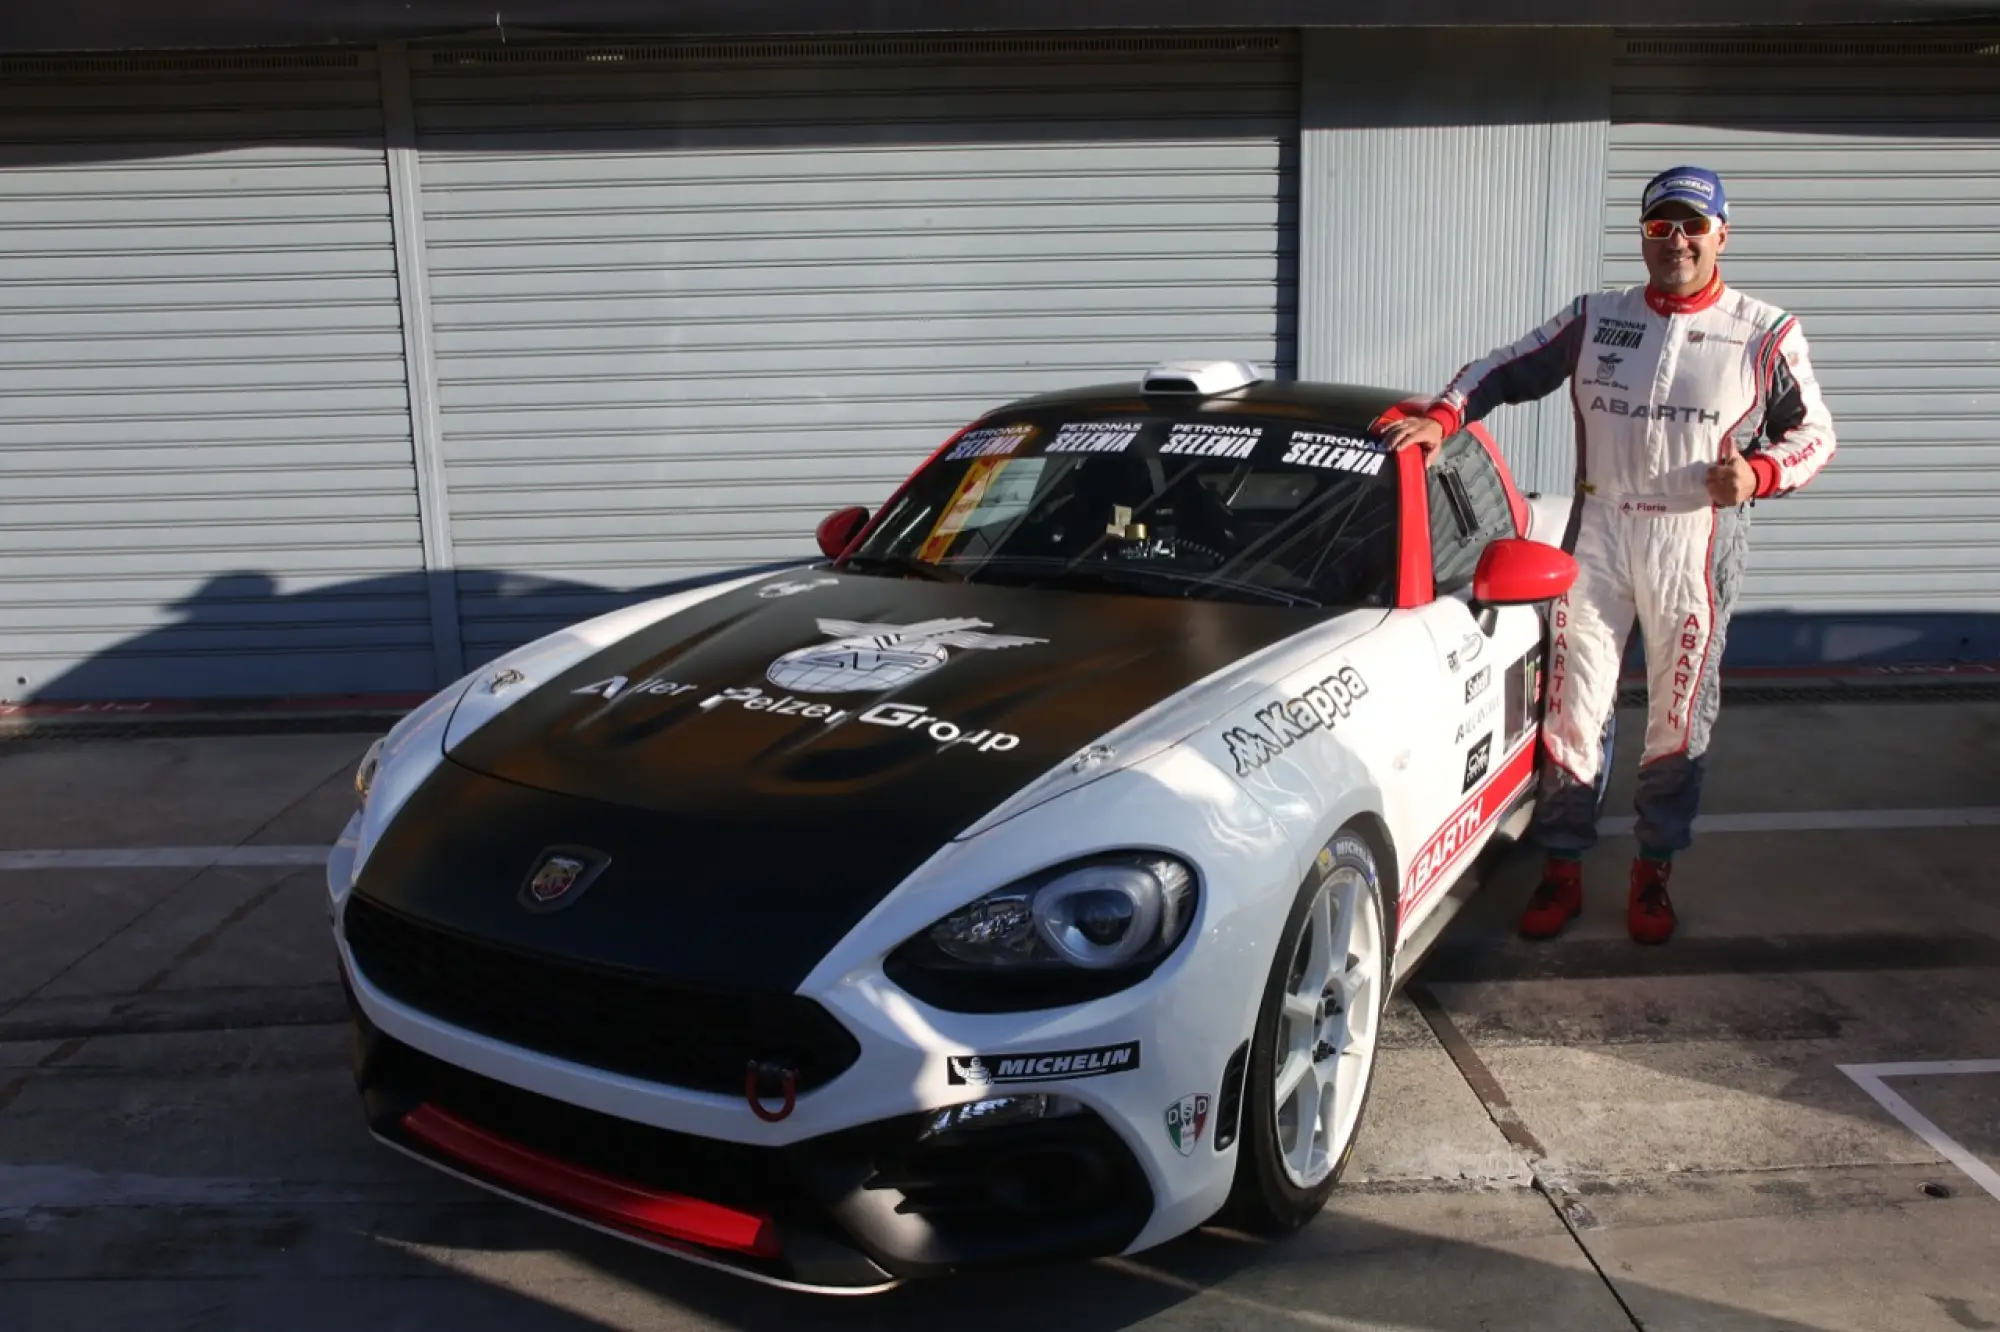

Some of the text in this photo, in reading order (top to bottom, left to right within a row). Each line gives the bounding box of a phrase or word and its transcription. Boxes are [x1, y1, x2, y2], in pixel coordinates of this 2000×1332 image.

[1590, 396, 1720, 425] ABARTH
[963, 424, 1033, 441] PETRONAS
[1044, 431, 1137, 452] SELENIA
[1060, 422, 1142, 432] PETRONAS
[1171, 423, 1263, 437] PETRONAS
[1291, 431, 1387, 452] PETRONAS
[1158, 433, 1259, 459] SELENIA
[1281, 441, 1387, 476] SELENIA
[1549, 592, 1571, 715] ABARTH
[1667, 613, 1700, 730] ABARTH
[699, 686, 846, 724] Pelzer
[859, 702, 1021, 753] Group
[1254, 666, 1369, 749] Kappa
[1404, 795, 1484, 900] ABARTH
[997, 1047, 1132, 1076] MICHELIN
